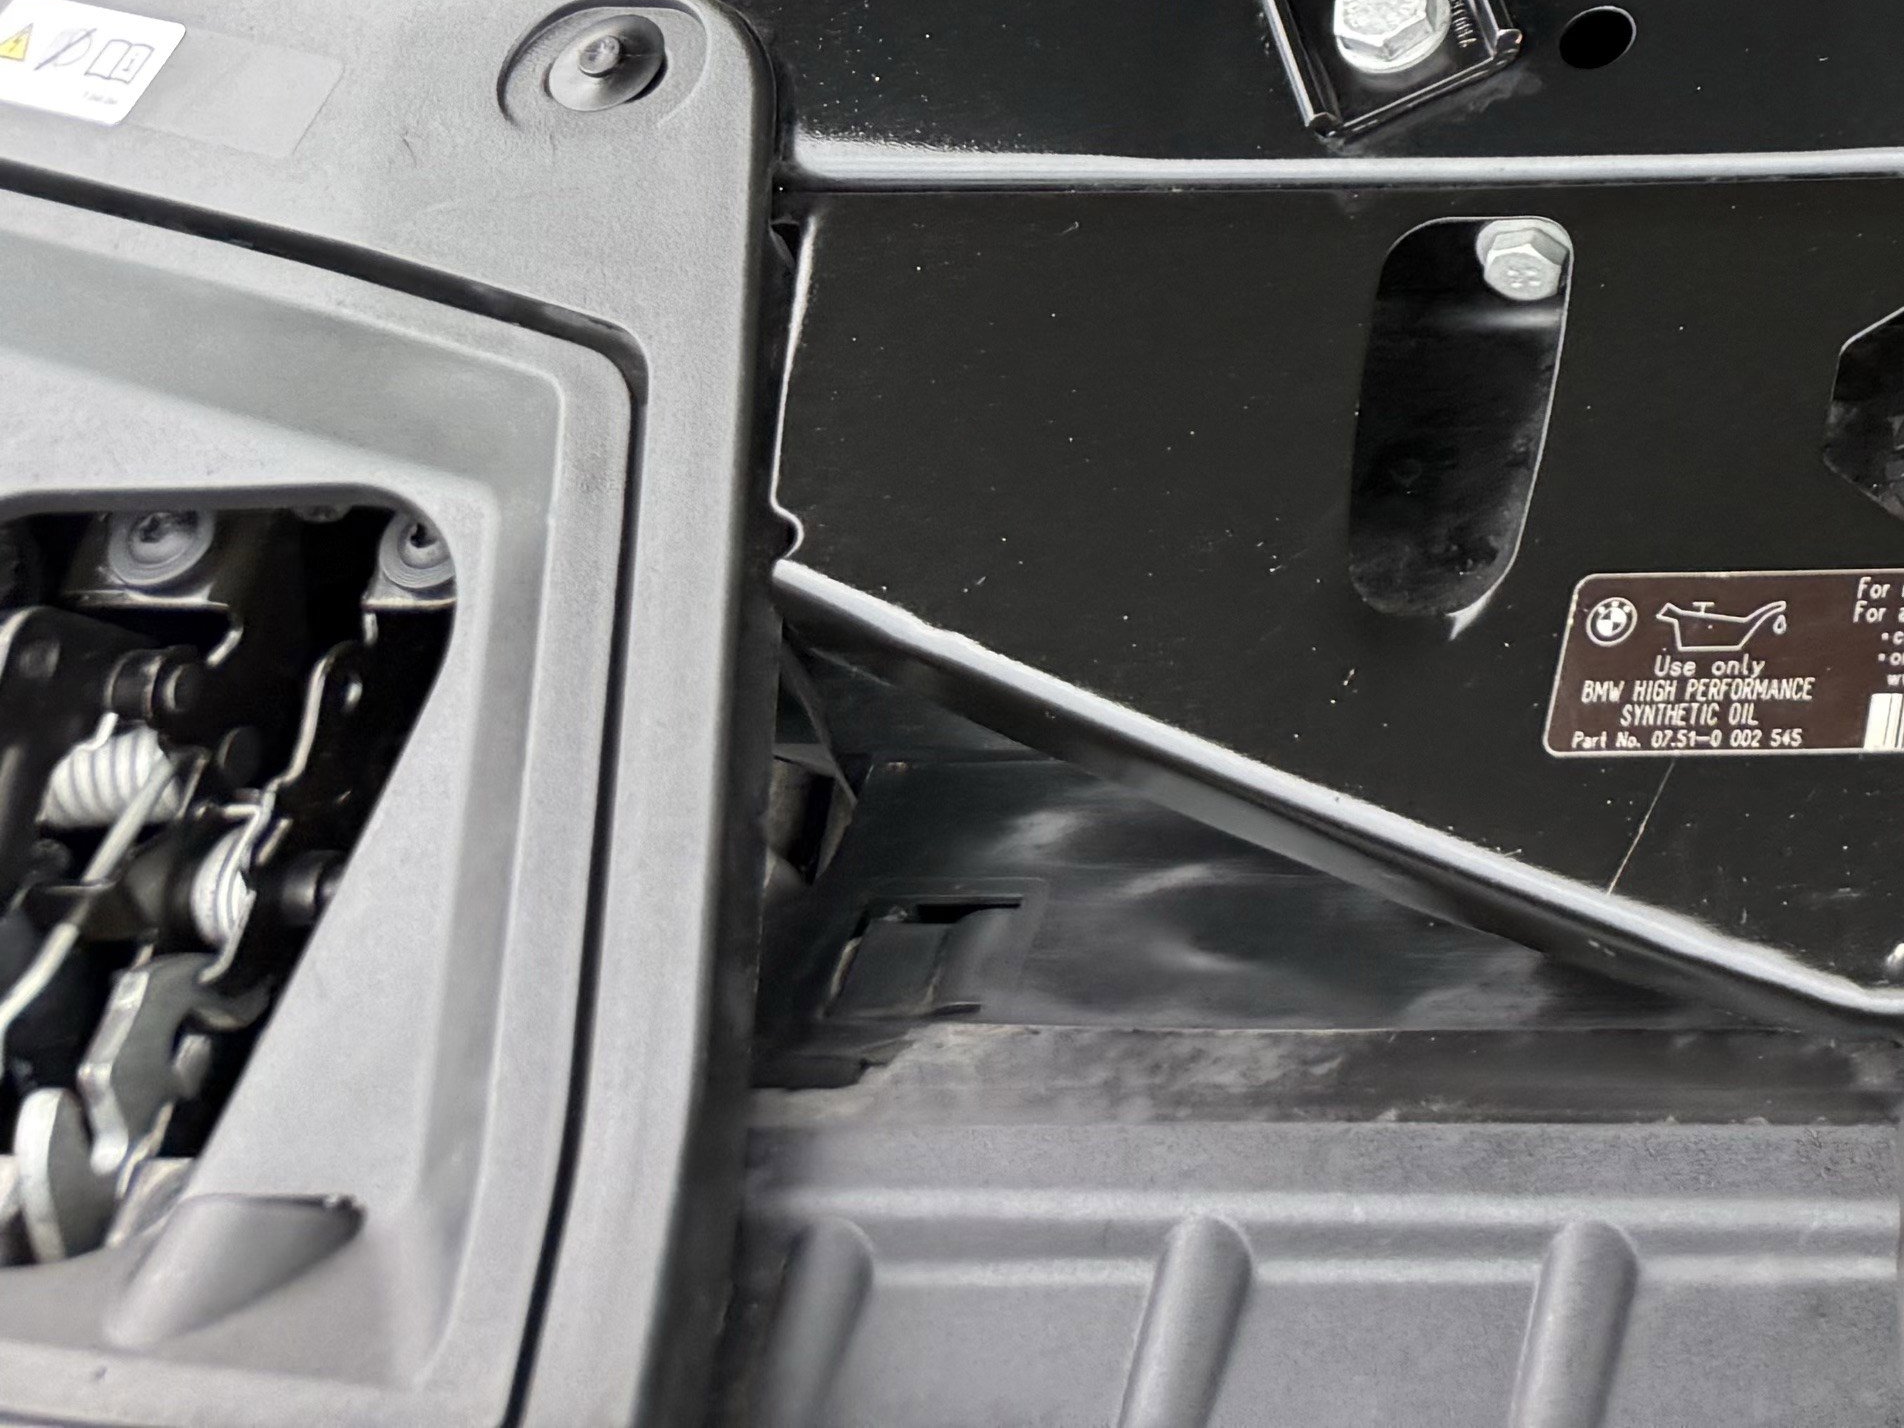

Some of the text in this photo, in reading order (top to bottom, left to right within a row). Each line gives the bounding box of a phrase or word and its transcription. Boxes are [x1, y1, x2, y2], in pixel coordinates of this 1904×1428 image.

[1856, 576, 1891, 600] For
[1852, 599, 1887, 624] For
[1653, 653, 1765, 678] Use only
[1580, 677, 1815, 705] BMW HIGH PERFORMANCE
[1619, 701, 1759, 728] SYNTHETIC OIL
[1570, 730, 1608, 750] Part
[1614, 730, 1642, 749] No.
[1729, 728, 1763, 748] 002
